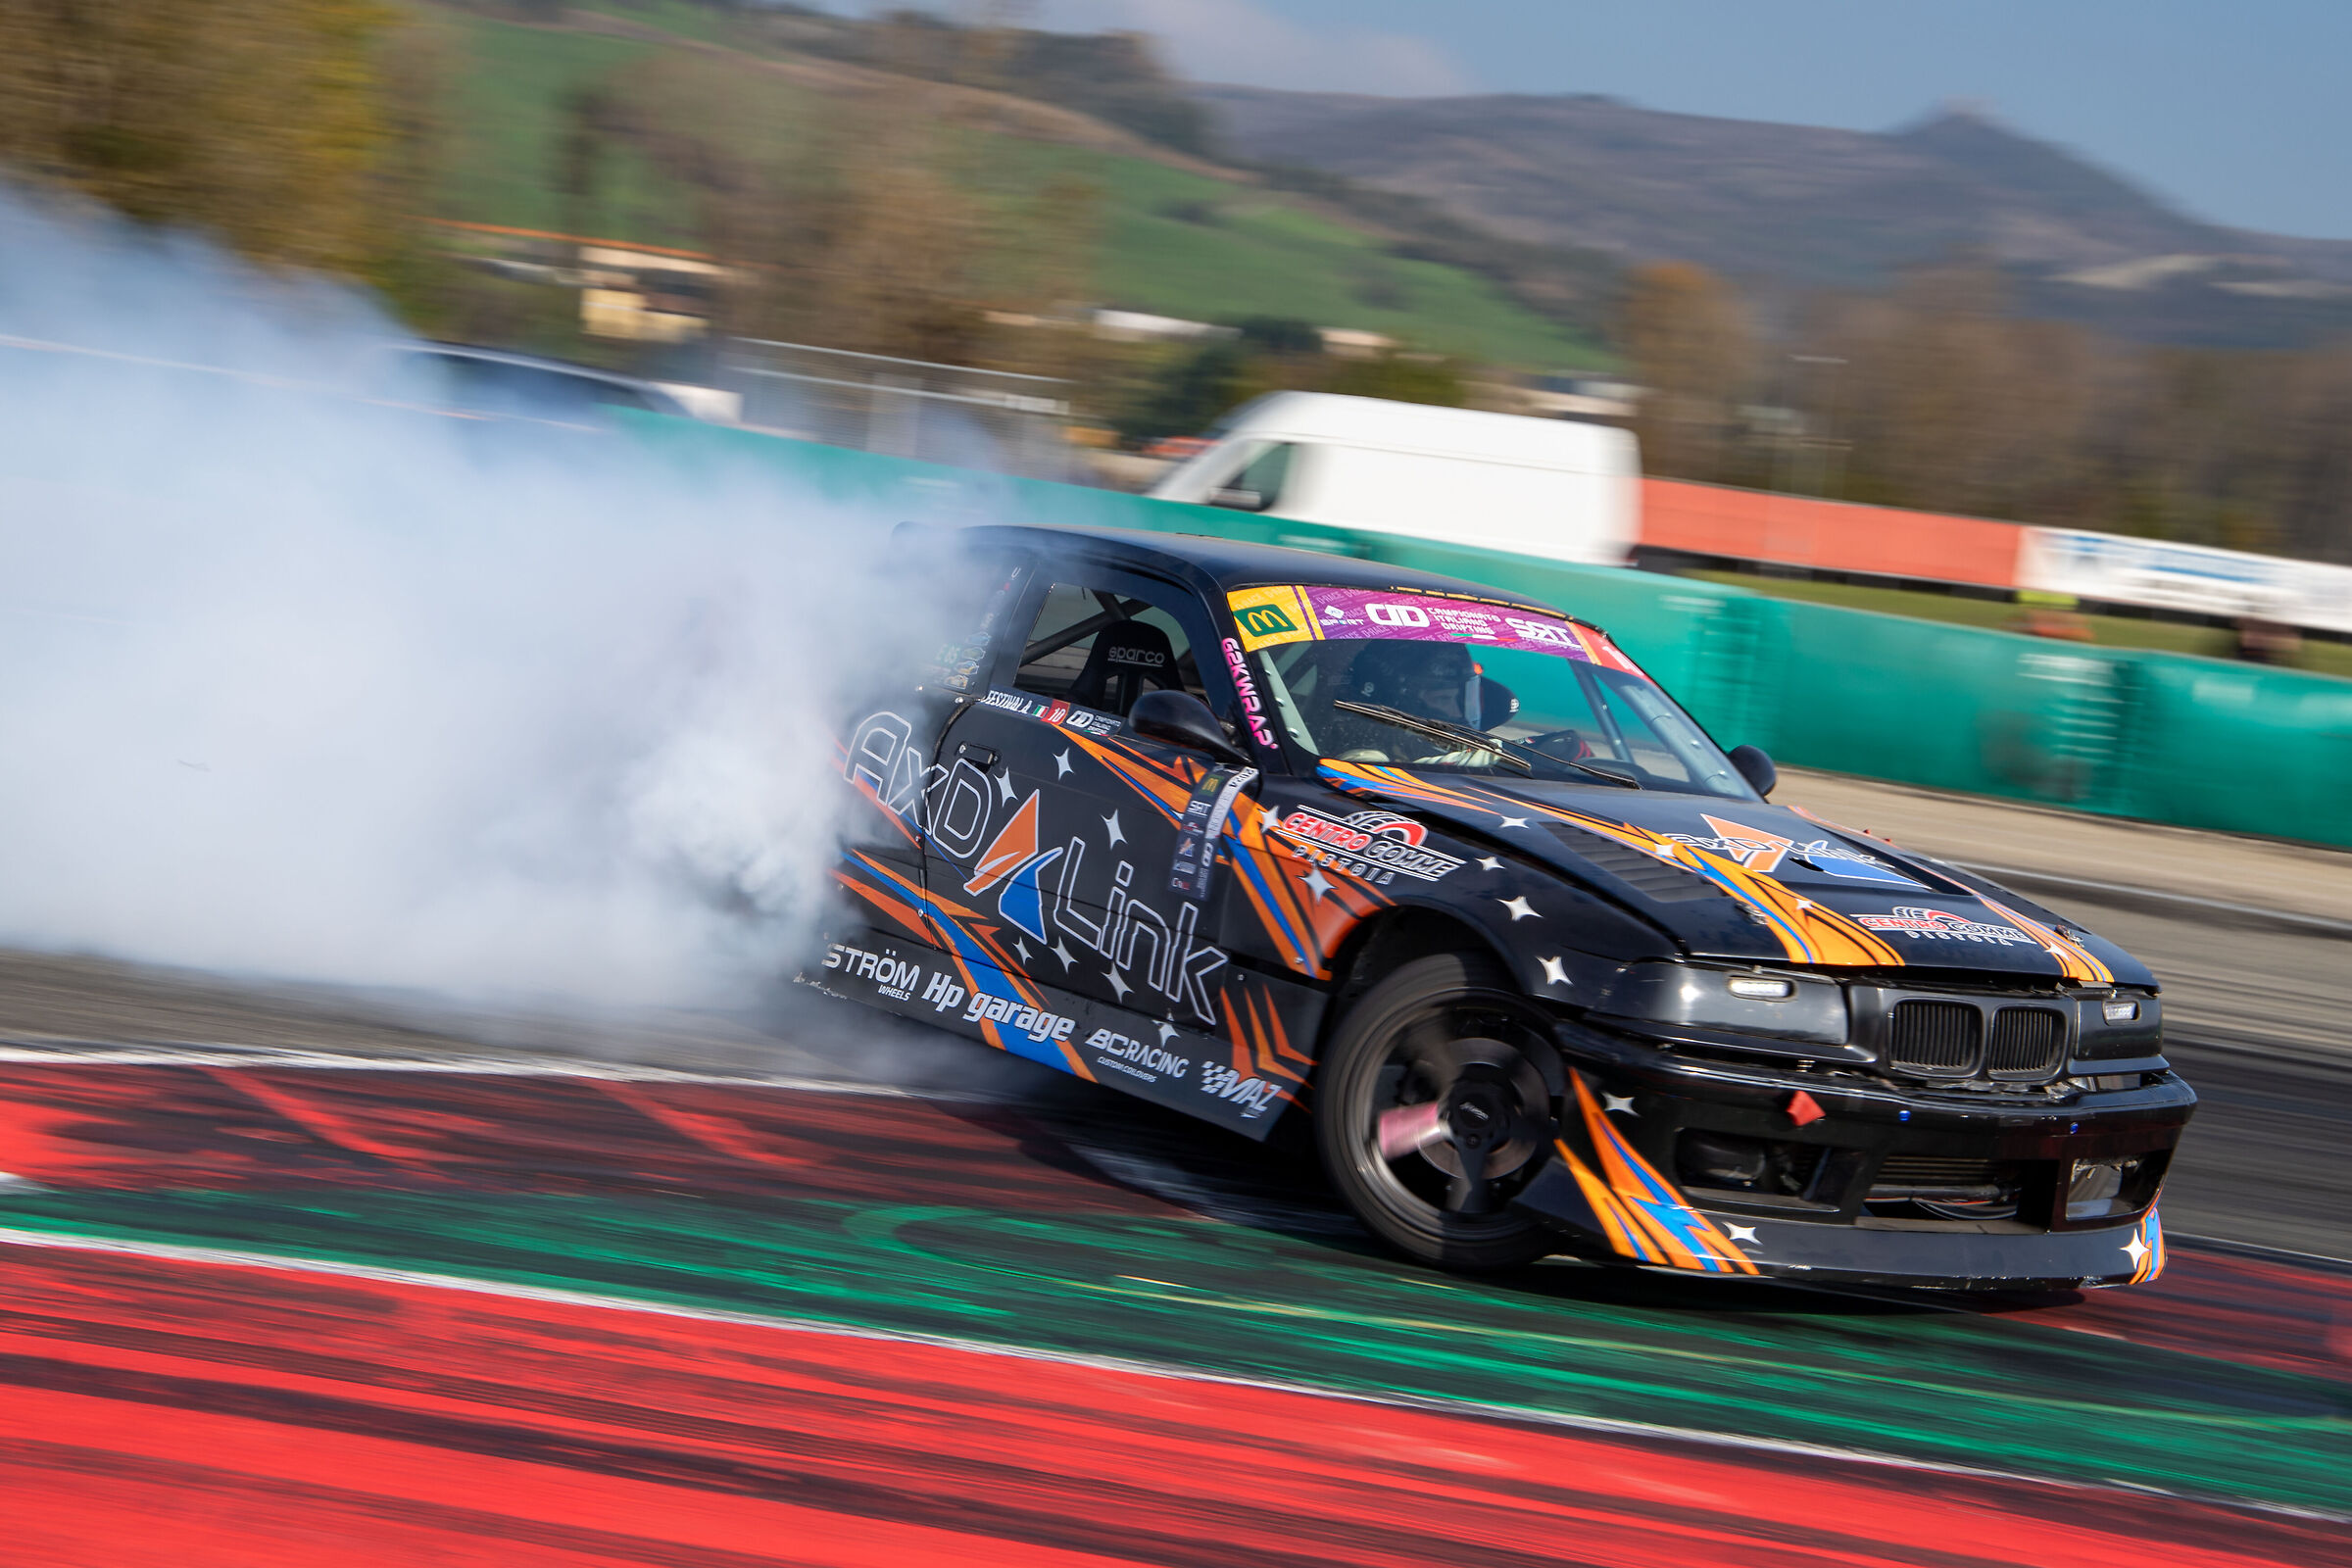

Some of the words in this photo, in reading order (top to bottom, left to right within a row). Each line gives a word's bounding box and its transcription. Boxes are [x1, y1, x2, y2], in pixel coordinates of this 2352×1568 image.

[1108, 646, 1165, 663] sparco
[1047, 707, 1066, 723] 10
[1282, 811, 1372, 852] CENTRO
[1363, 840, 1462, 878] GOMME
[1292, 845, 1396, 885] PISTOIA
[1858, 917, 1949, 930] CENTRO
[821, 943, 921, 991] STRÖM
[878, 984, 911, 1002] WHEELS
[921, 971, 965, 1012] Hp
[962, 992, 1076, 1043] garage
